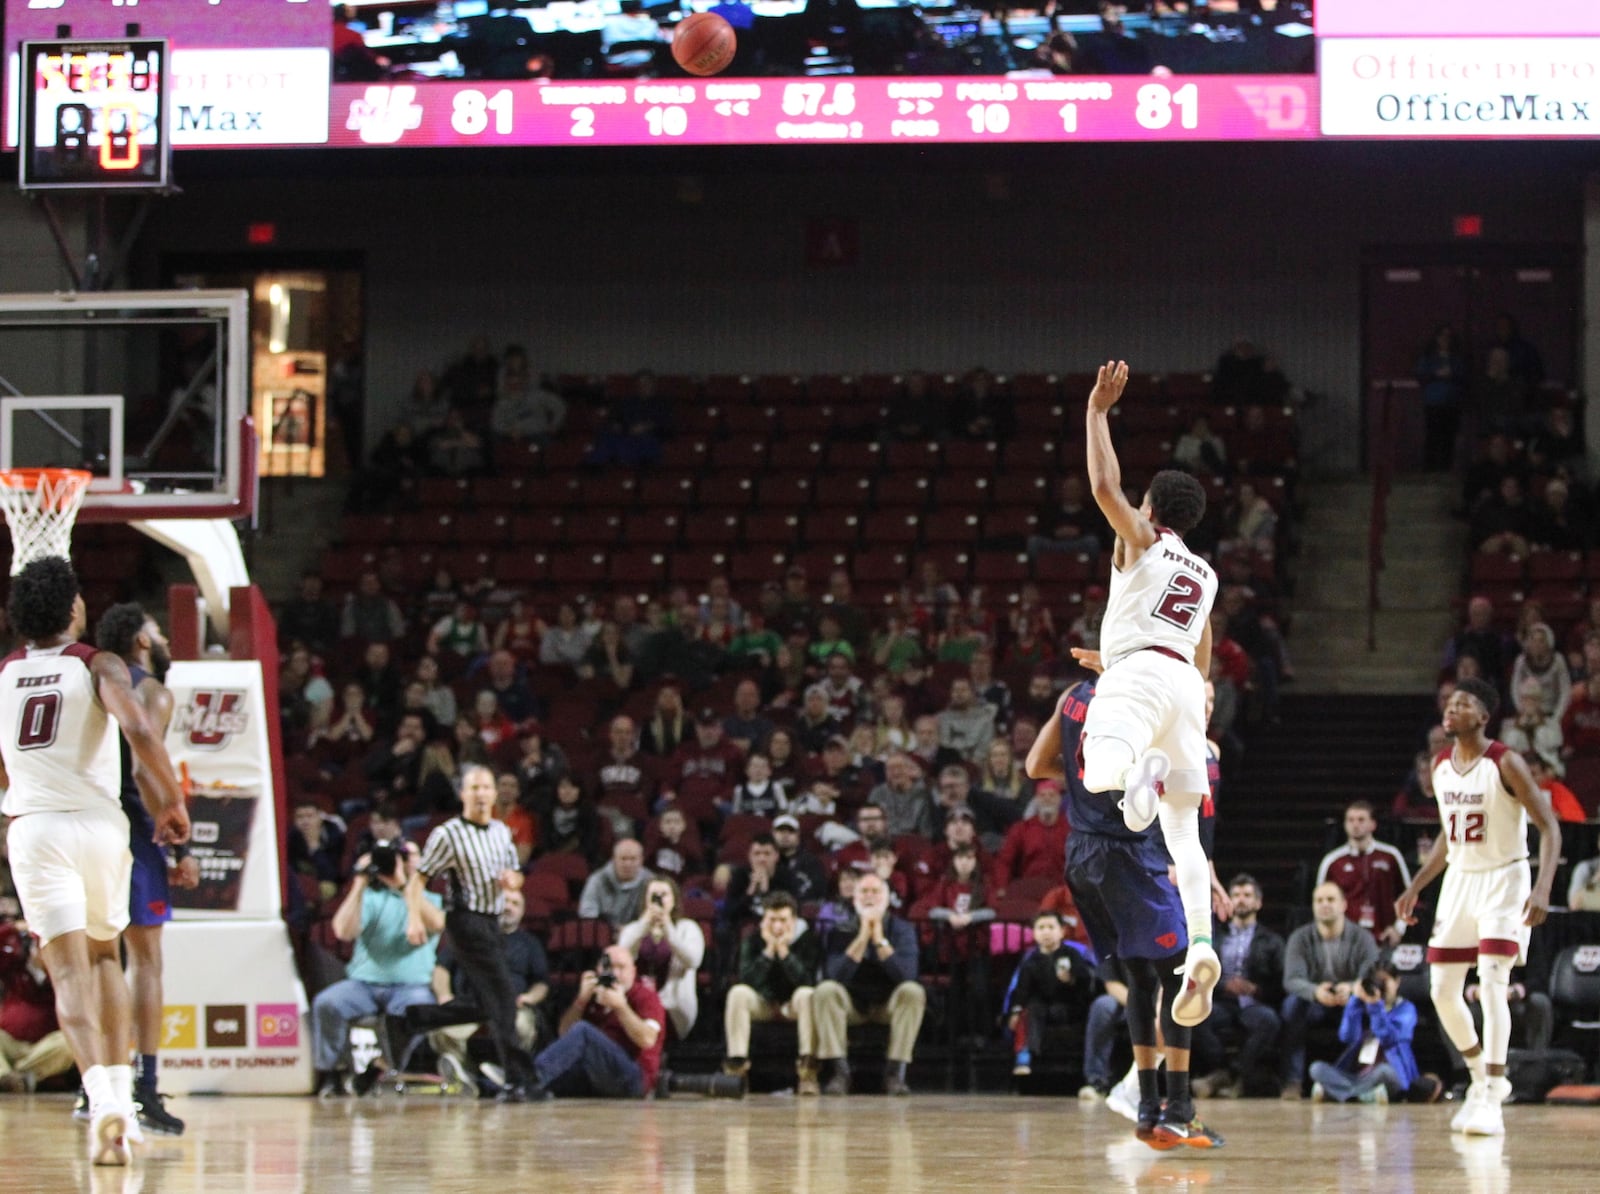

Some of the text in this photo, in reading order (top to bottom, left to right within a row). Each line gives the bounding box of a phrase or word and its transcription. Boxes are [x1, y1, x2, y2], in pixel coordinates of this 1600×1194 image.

[176, 105, 263, 131] Max
[451, 89, 513, 134] 81
[645, 106, 688, 136] 10
[966, 104, 1010, 134] 10
[1058, 103, 1077, 133] 1
[1135, 83, 1198, 129] 81
[1376, 93, 1592, 122] OfficeMax
[570, 107, 595, 136] 2
[1151, 571, 1205, 632] 2
[15, 690, 63, 751] 0
[1448, 811, 1488, 844] 12
[209, 1057, 231, 1068] ON
